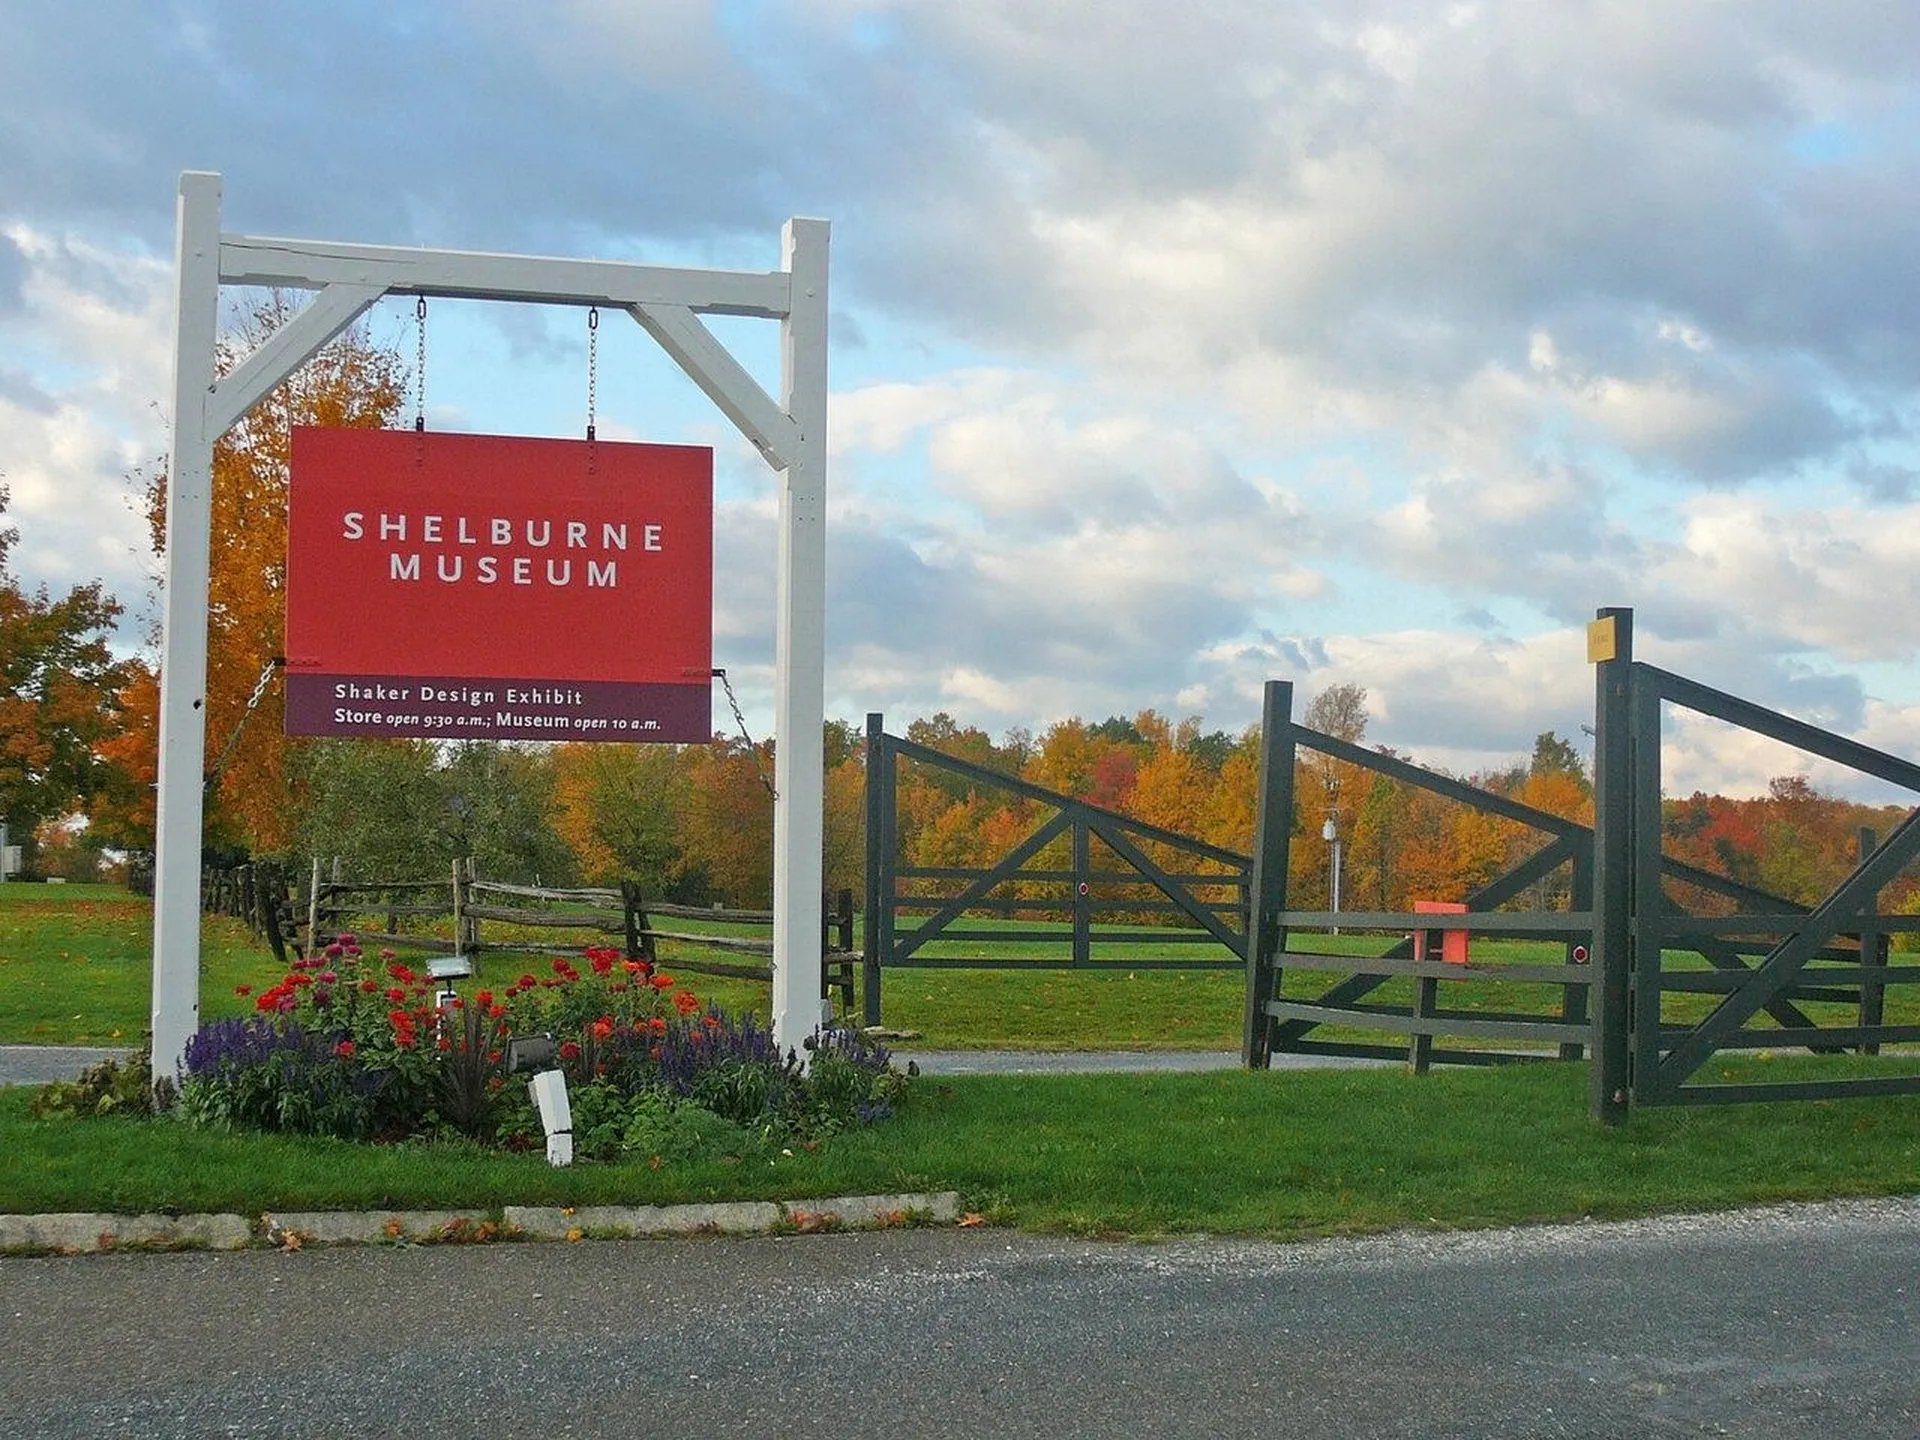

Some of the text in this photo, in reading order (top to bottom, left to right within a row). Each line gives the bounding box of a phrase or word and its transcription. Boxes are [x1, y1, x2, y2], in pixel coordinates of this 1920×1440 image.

[342, 511, 664, 552] SHELBURNE
[389, 552, 618, 588] MUSEUM
[334, 683, 583, 707] Shaker Design Exhibit
[334, 707, 662, 731] Store open 9:30 a.m.; Museum open 10 a.m.
